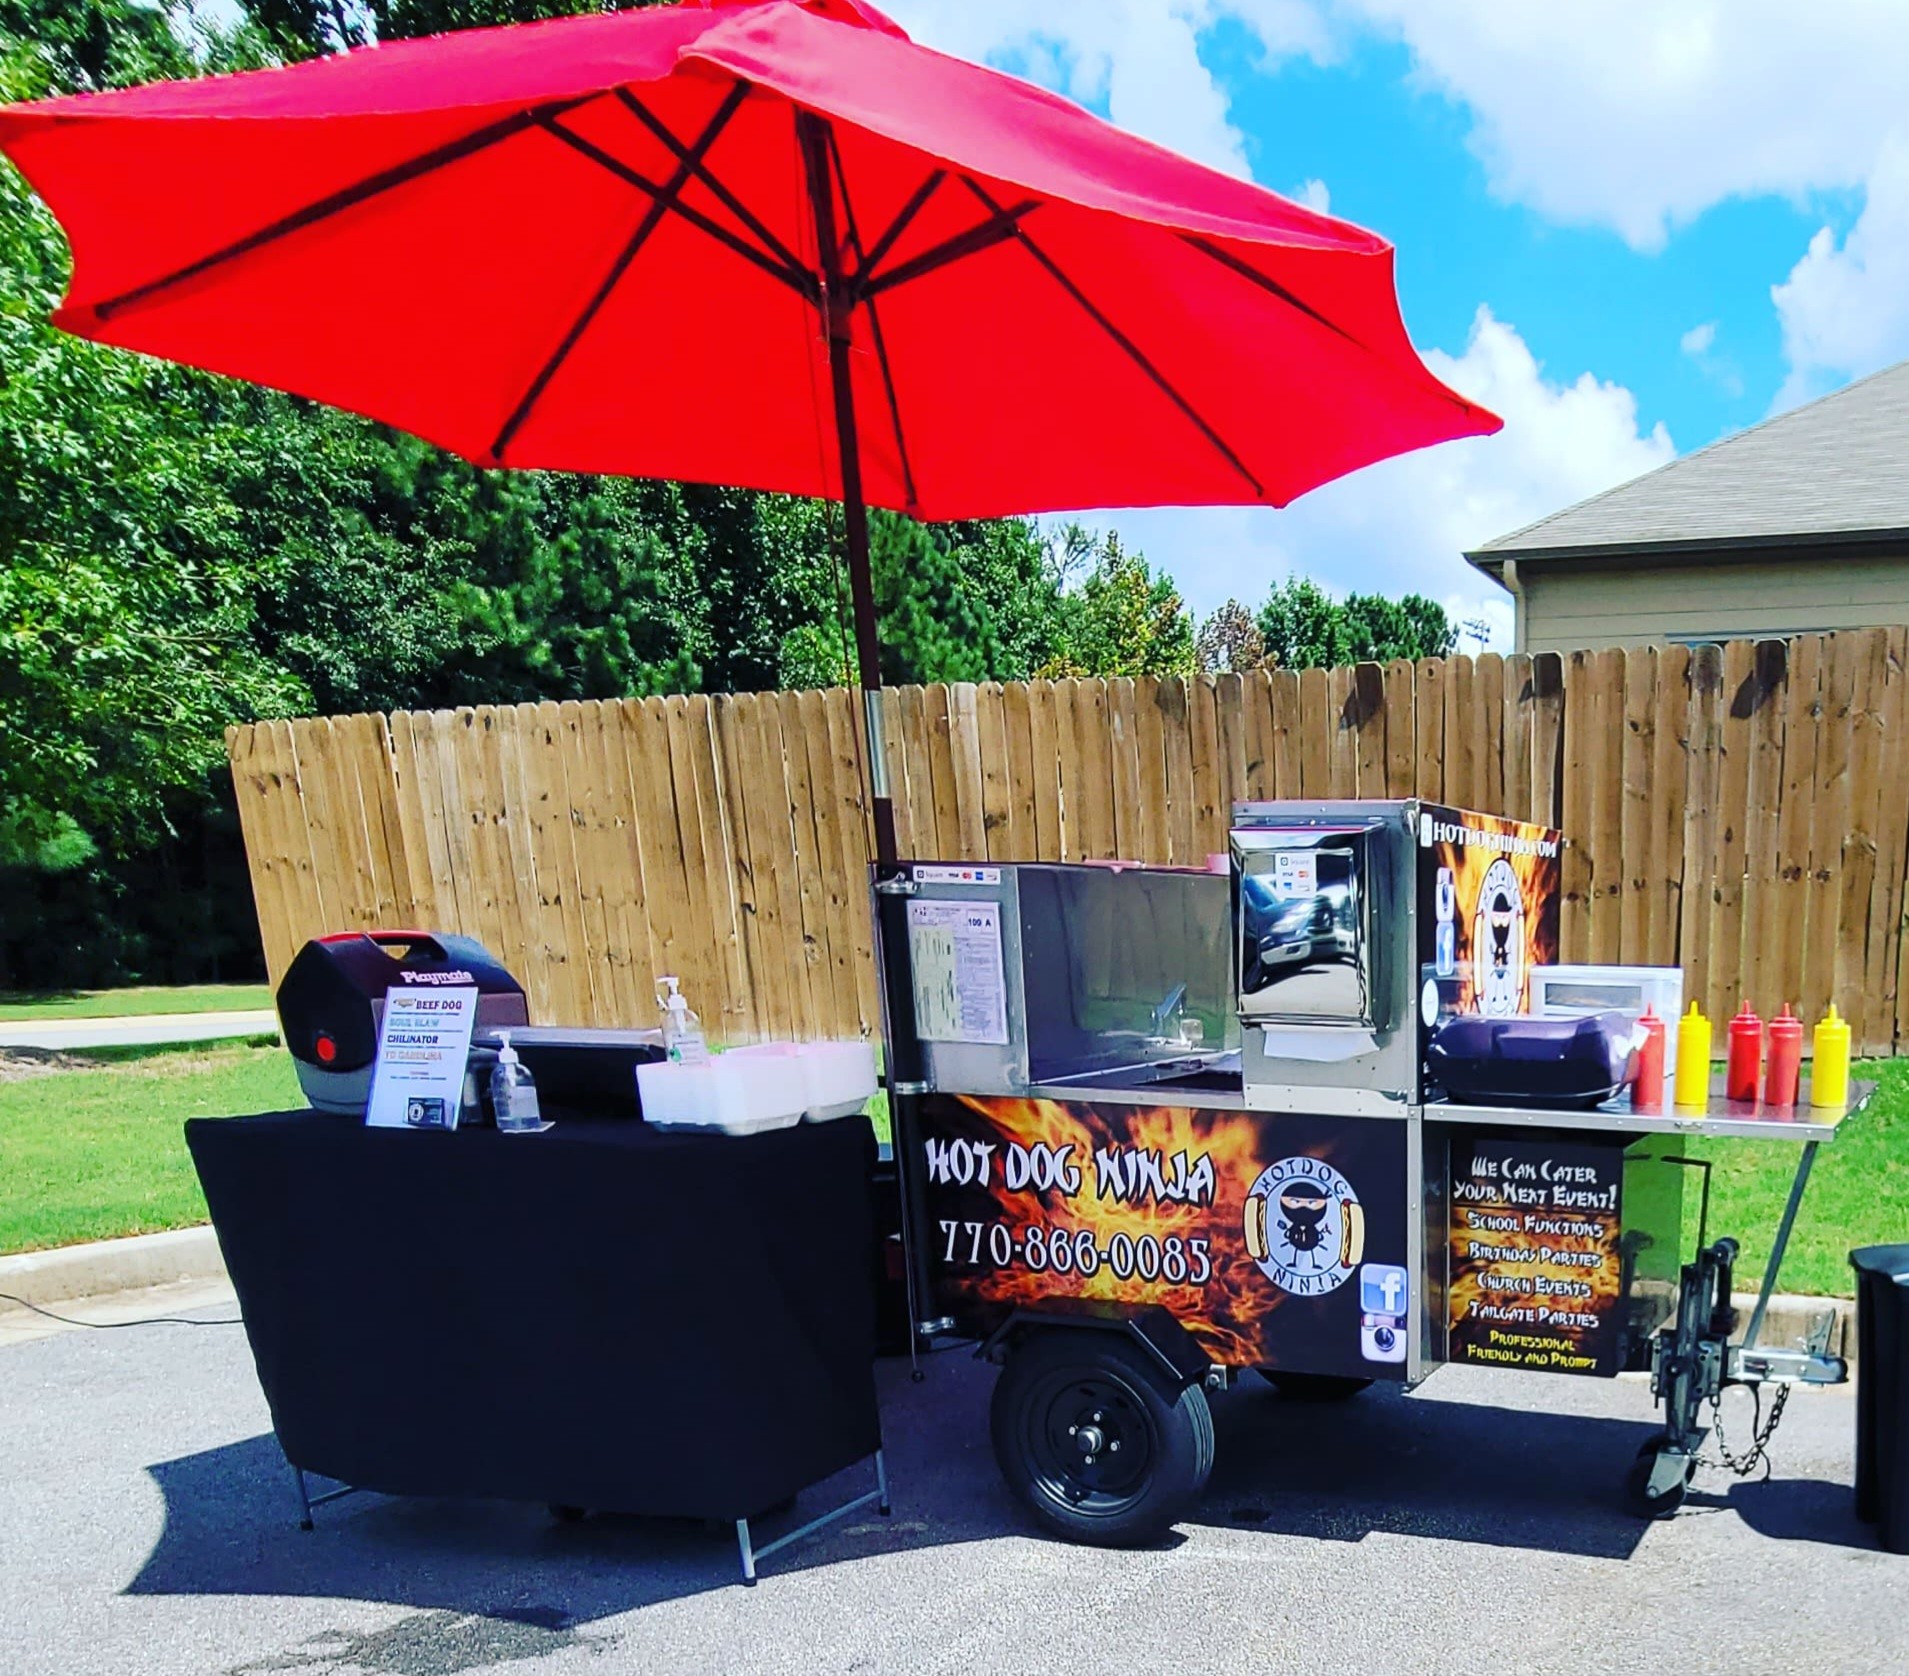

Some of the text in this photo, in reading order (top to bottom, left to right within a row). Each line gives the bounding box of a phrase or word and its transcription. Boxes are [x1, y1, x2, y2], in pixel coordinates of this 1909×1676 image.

[400, 970, 475, 985] Playmate
[416, 1000, 463, 1010] BEEF DOG
[924, 1137, 1215, 1203] HOT DOG NINJA
[1260, 1159, 1348, 1196] HOTDOG
[938, 1219, 1211, 1284] 770-866-0085
[1272, 1268, 1343, 1294] NINJA
